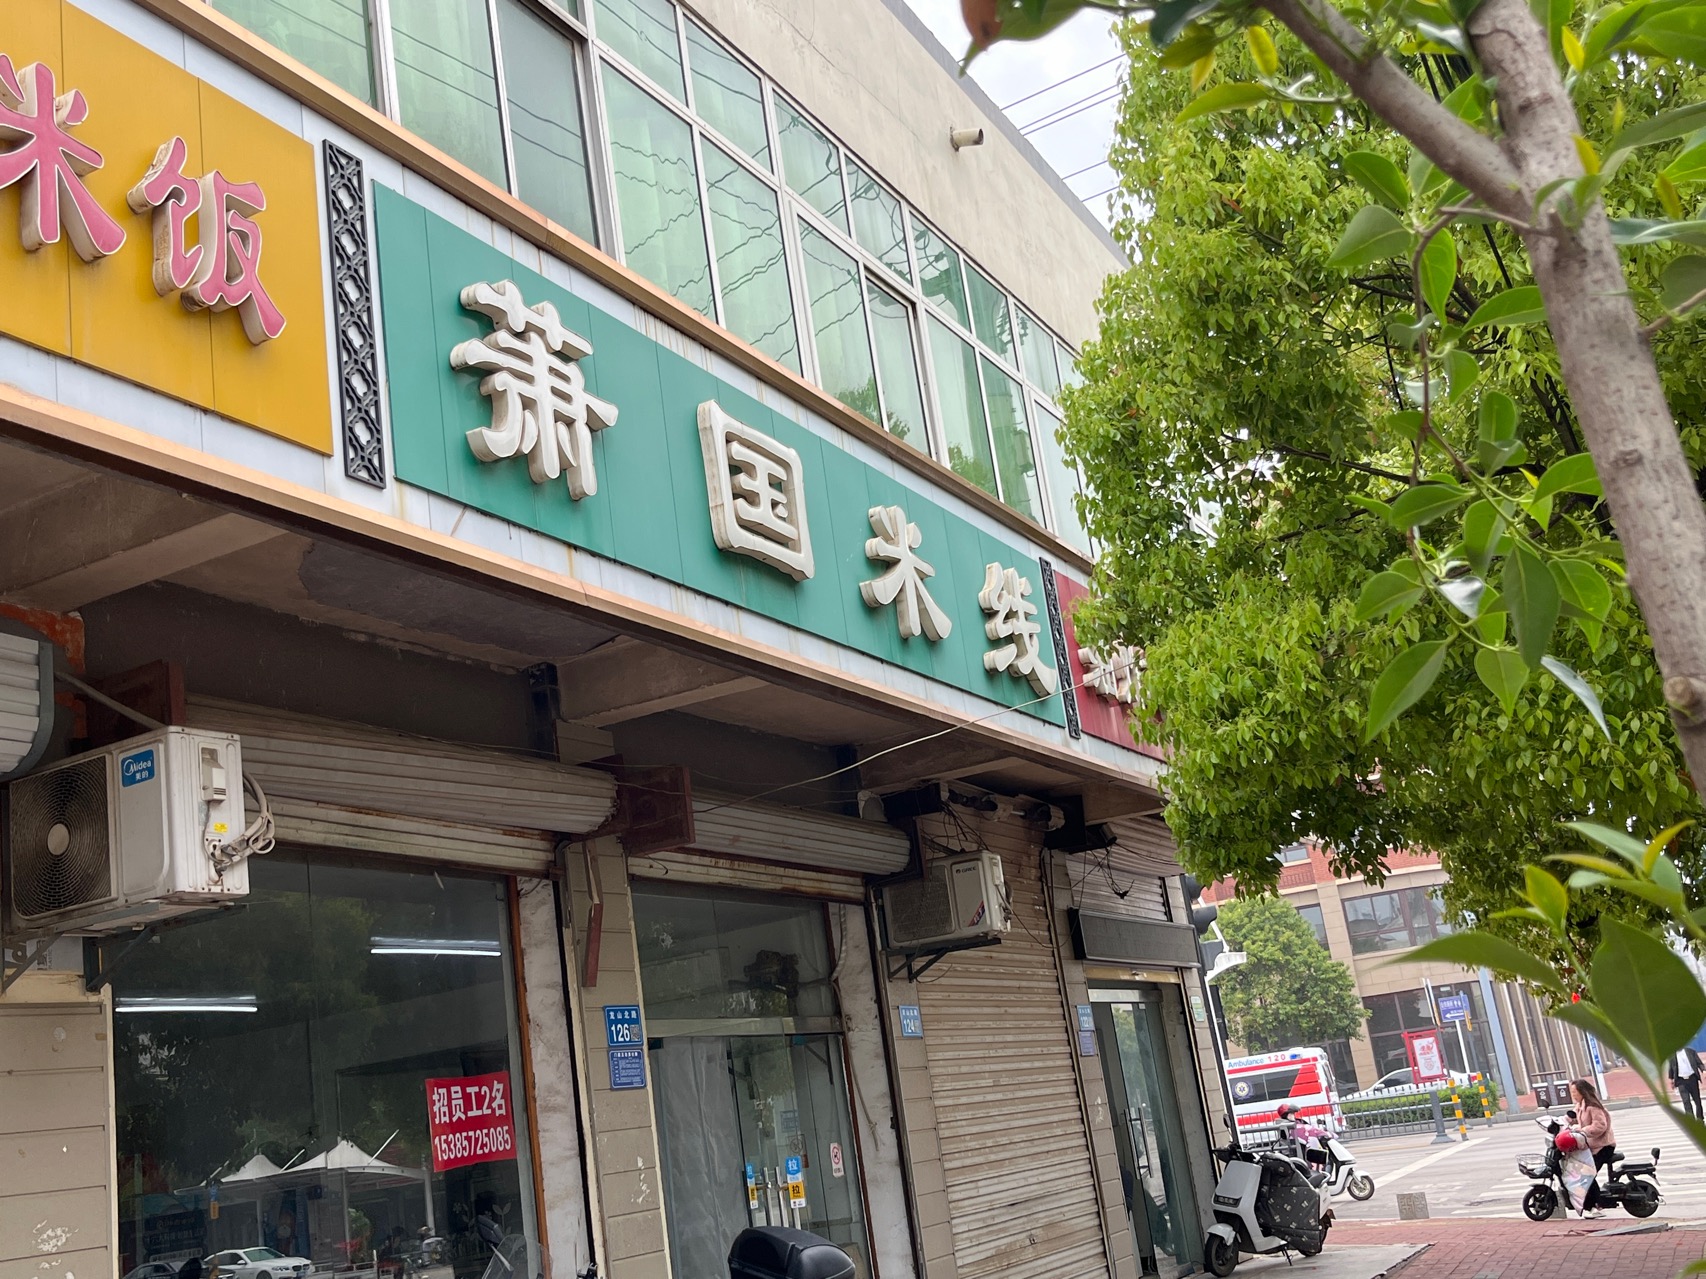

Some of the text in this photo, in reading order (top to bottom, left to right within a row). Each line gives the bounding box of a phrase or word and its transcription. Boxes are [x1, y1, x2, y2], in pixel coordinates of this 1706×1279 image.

[0, 53, 287, 346] 米饭
[449, 279, 1057, 698] 萧国米线
[124, 759, 152, 776] Midea
[611, 1023, 630, 1042] 126
[1228, 1058, 1265, 1069] Ambulance
[432, 1080, 506, 1124] 招员工2名
[434, 1125, 511, 1162] 15385725085
[788, 1159, 798, 1171] 拉
[792, 1184, 801, 1194] 拉
